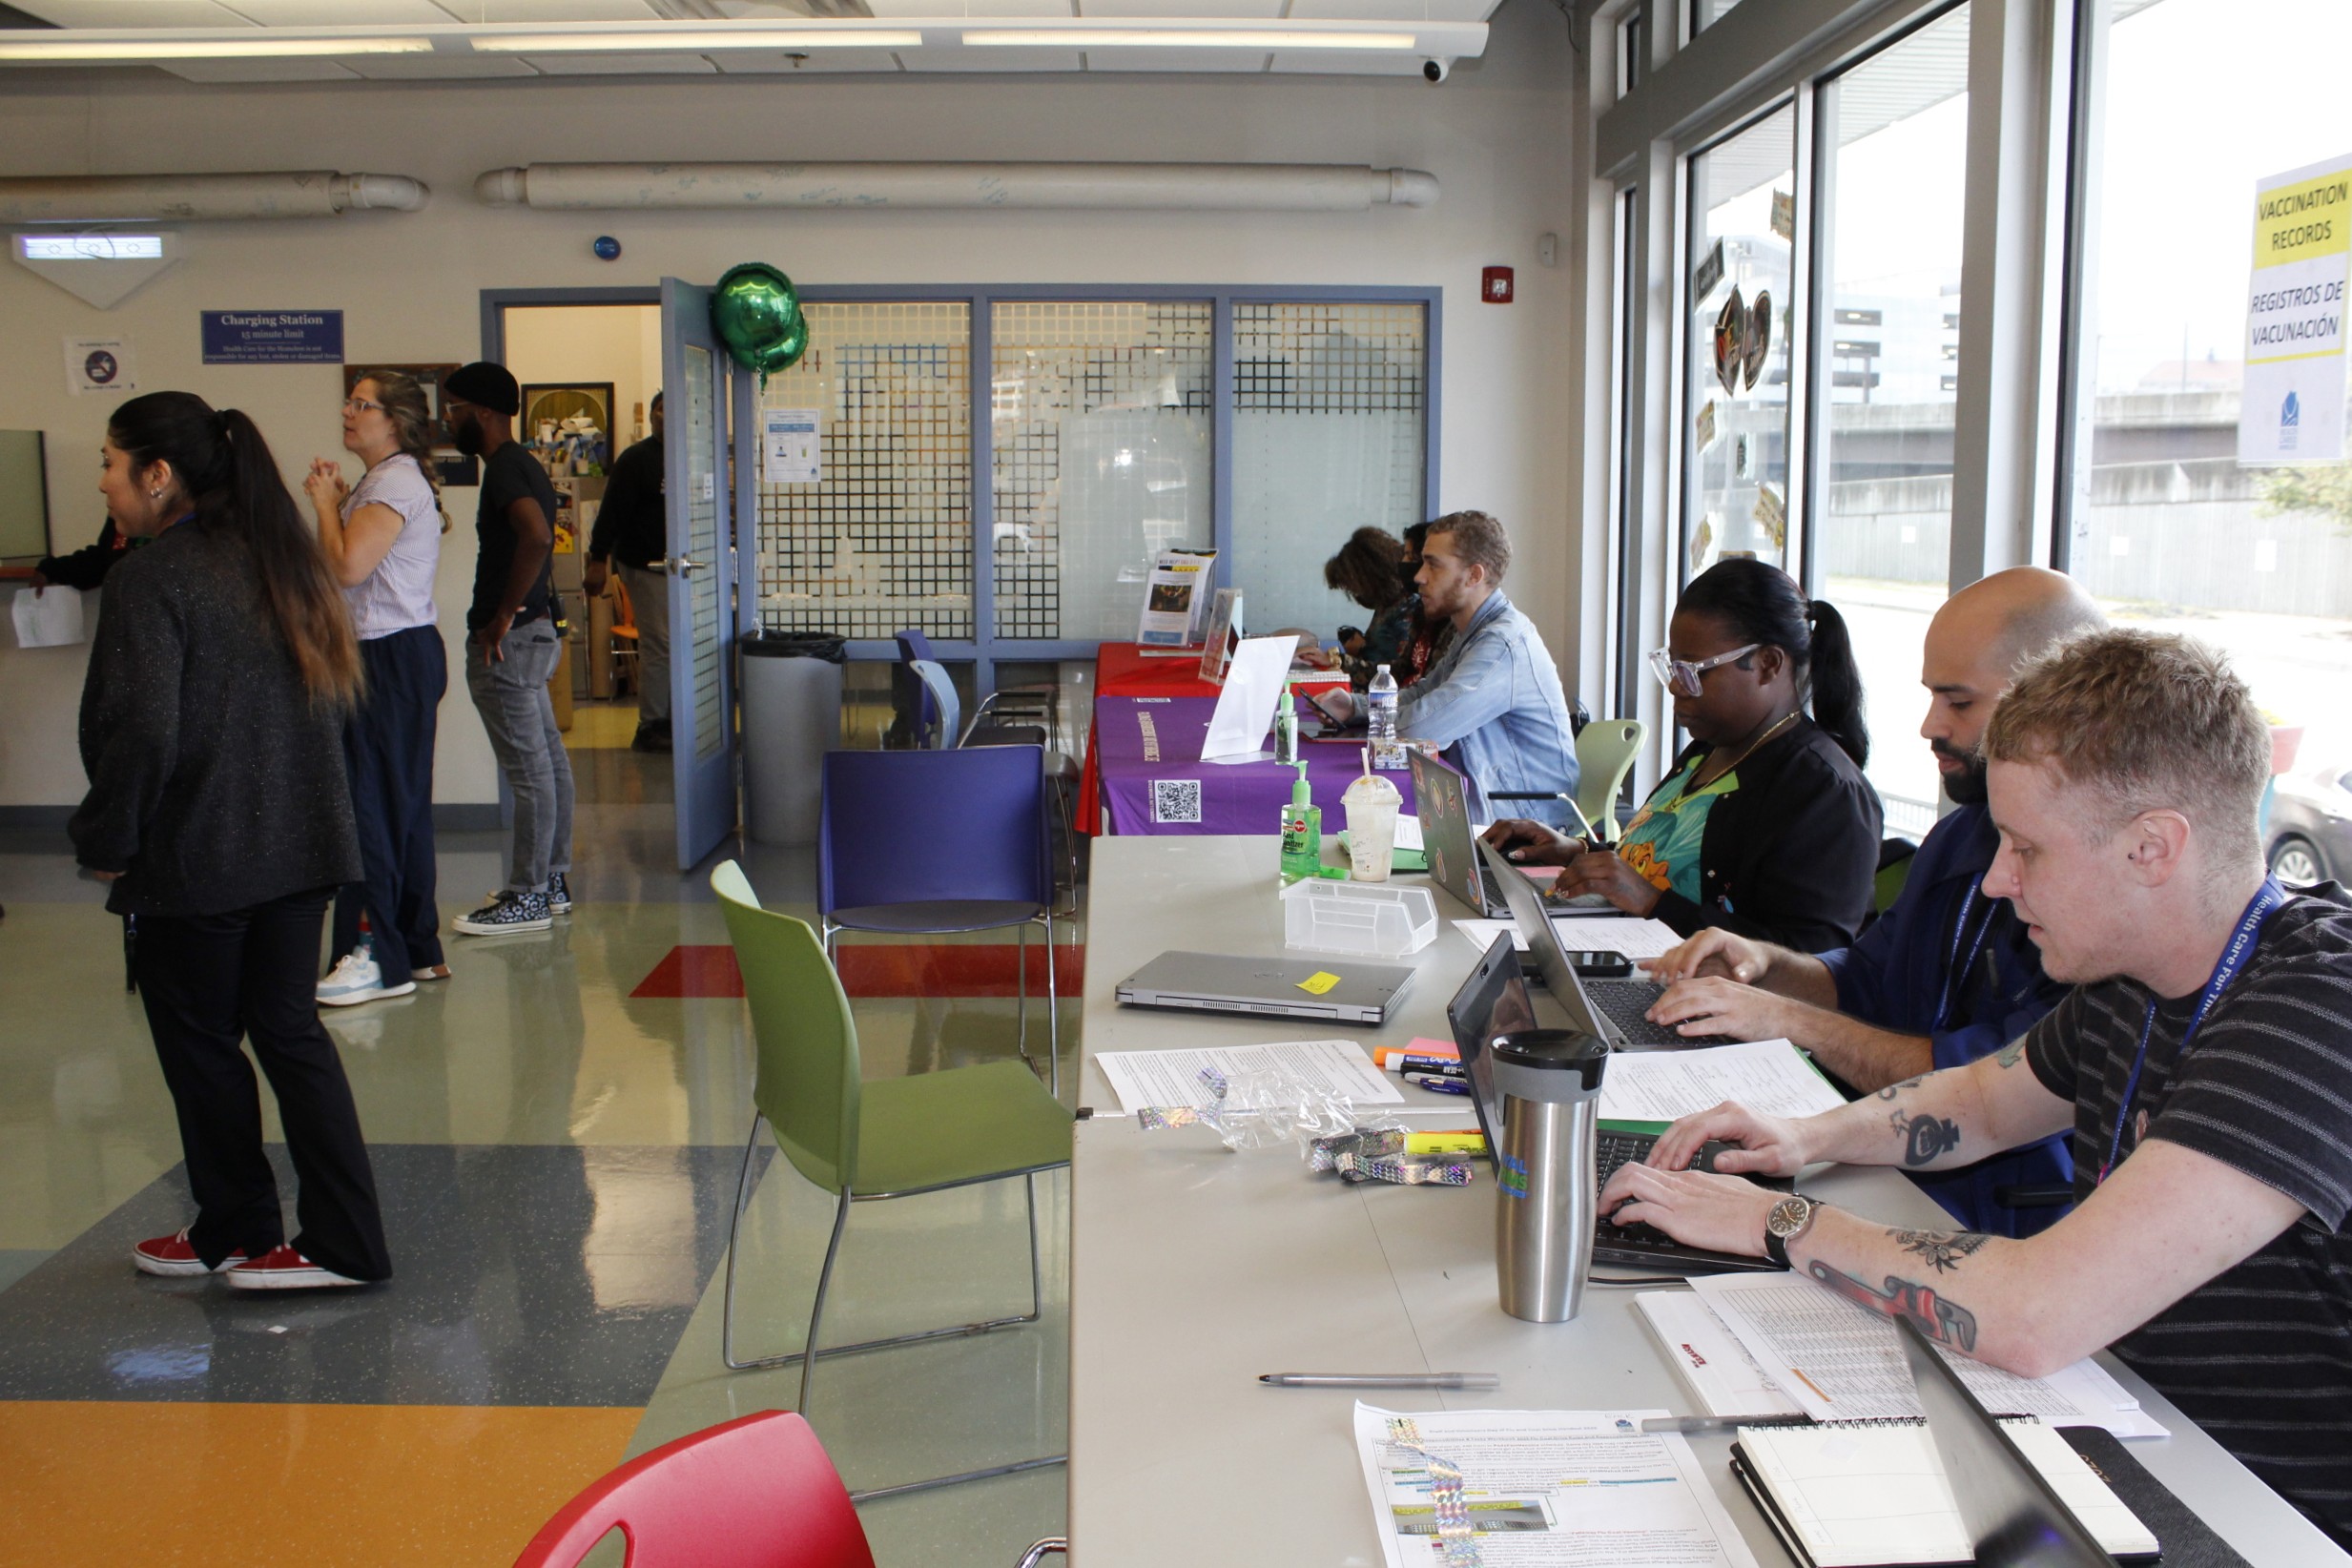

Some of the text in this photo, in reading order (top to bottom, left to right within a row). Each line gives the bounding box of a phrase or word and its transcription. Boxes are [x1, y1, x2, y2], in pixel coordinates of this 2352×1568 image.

[2259, 181, 2348, 221] VACCINATION
[2272, 219, 2332, 251] RECORDS
[2251, 280, 2344, 314] REGISTROS DE
[220, 314, 324, 328] Charging Station
[241, 329, 304, 340] 15 minute limit
[2252, 312, 2339, 345] VACUNACIÓN
[2242, 895, 2273, 932] Health
[2226, 933, 2249, 966] Care
[2213, 966, 2233, 992] For
